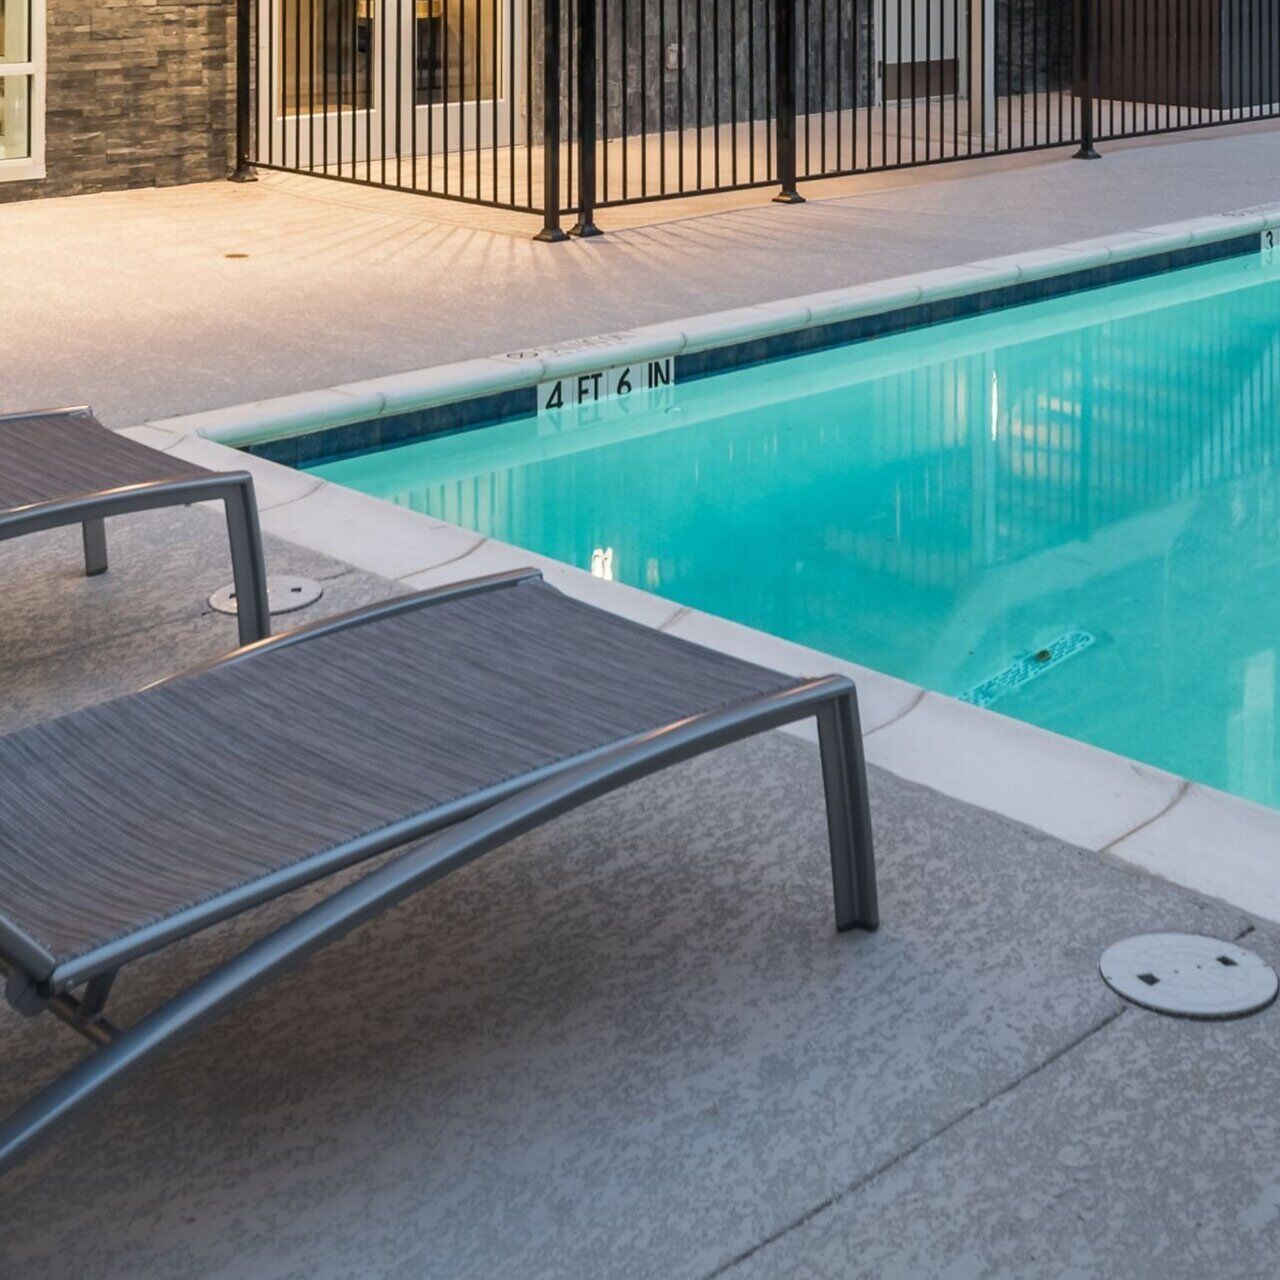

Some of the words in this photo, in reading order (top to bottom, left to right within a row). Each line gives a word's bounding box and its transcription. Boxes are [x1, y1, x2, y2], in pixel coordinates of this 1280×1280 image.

[1266, 231, 1274, 250] 3
[545, 381, 564, 409] 4
[578, 373, 602, 404] FT
[616, 367, 632, 395] 6
[648, 359, 670, 389] IN
